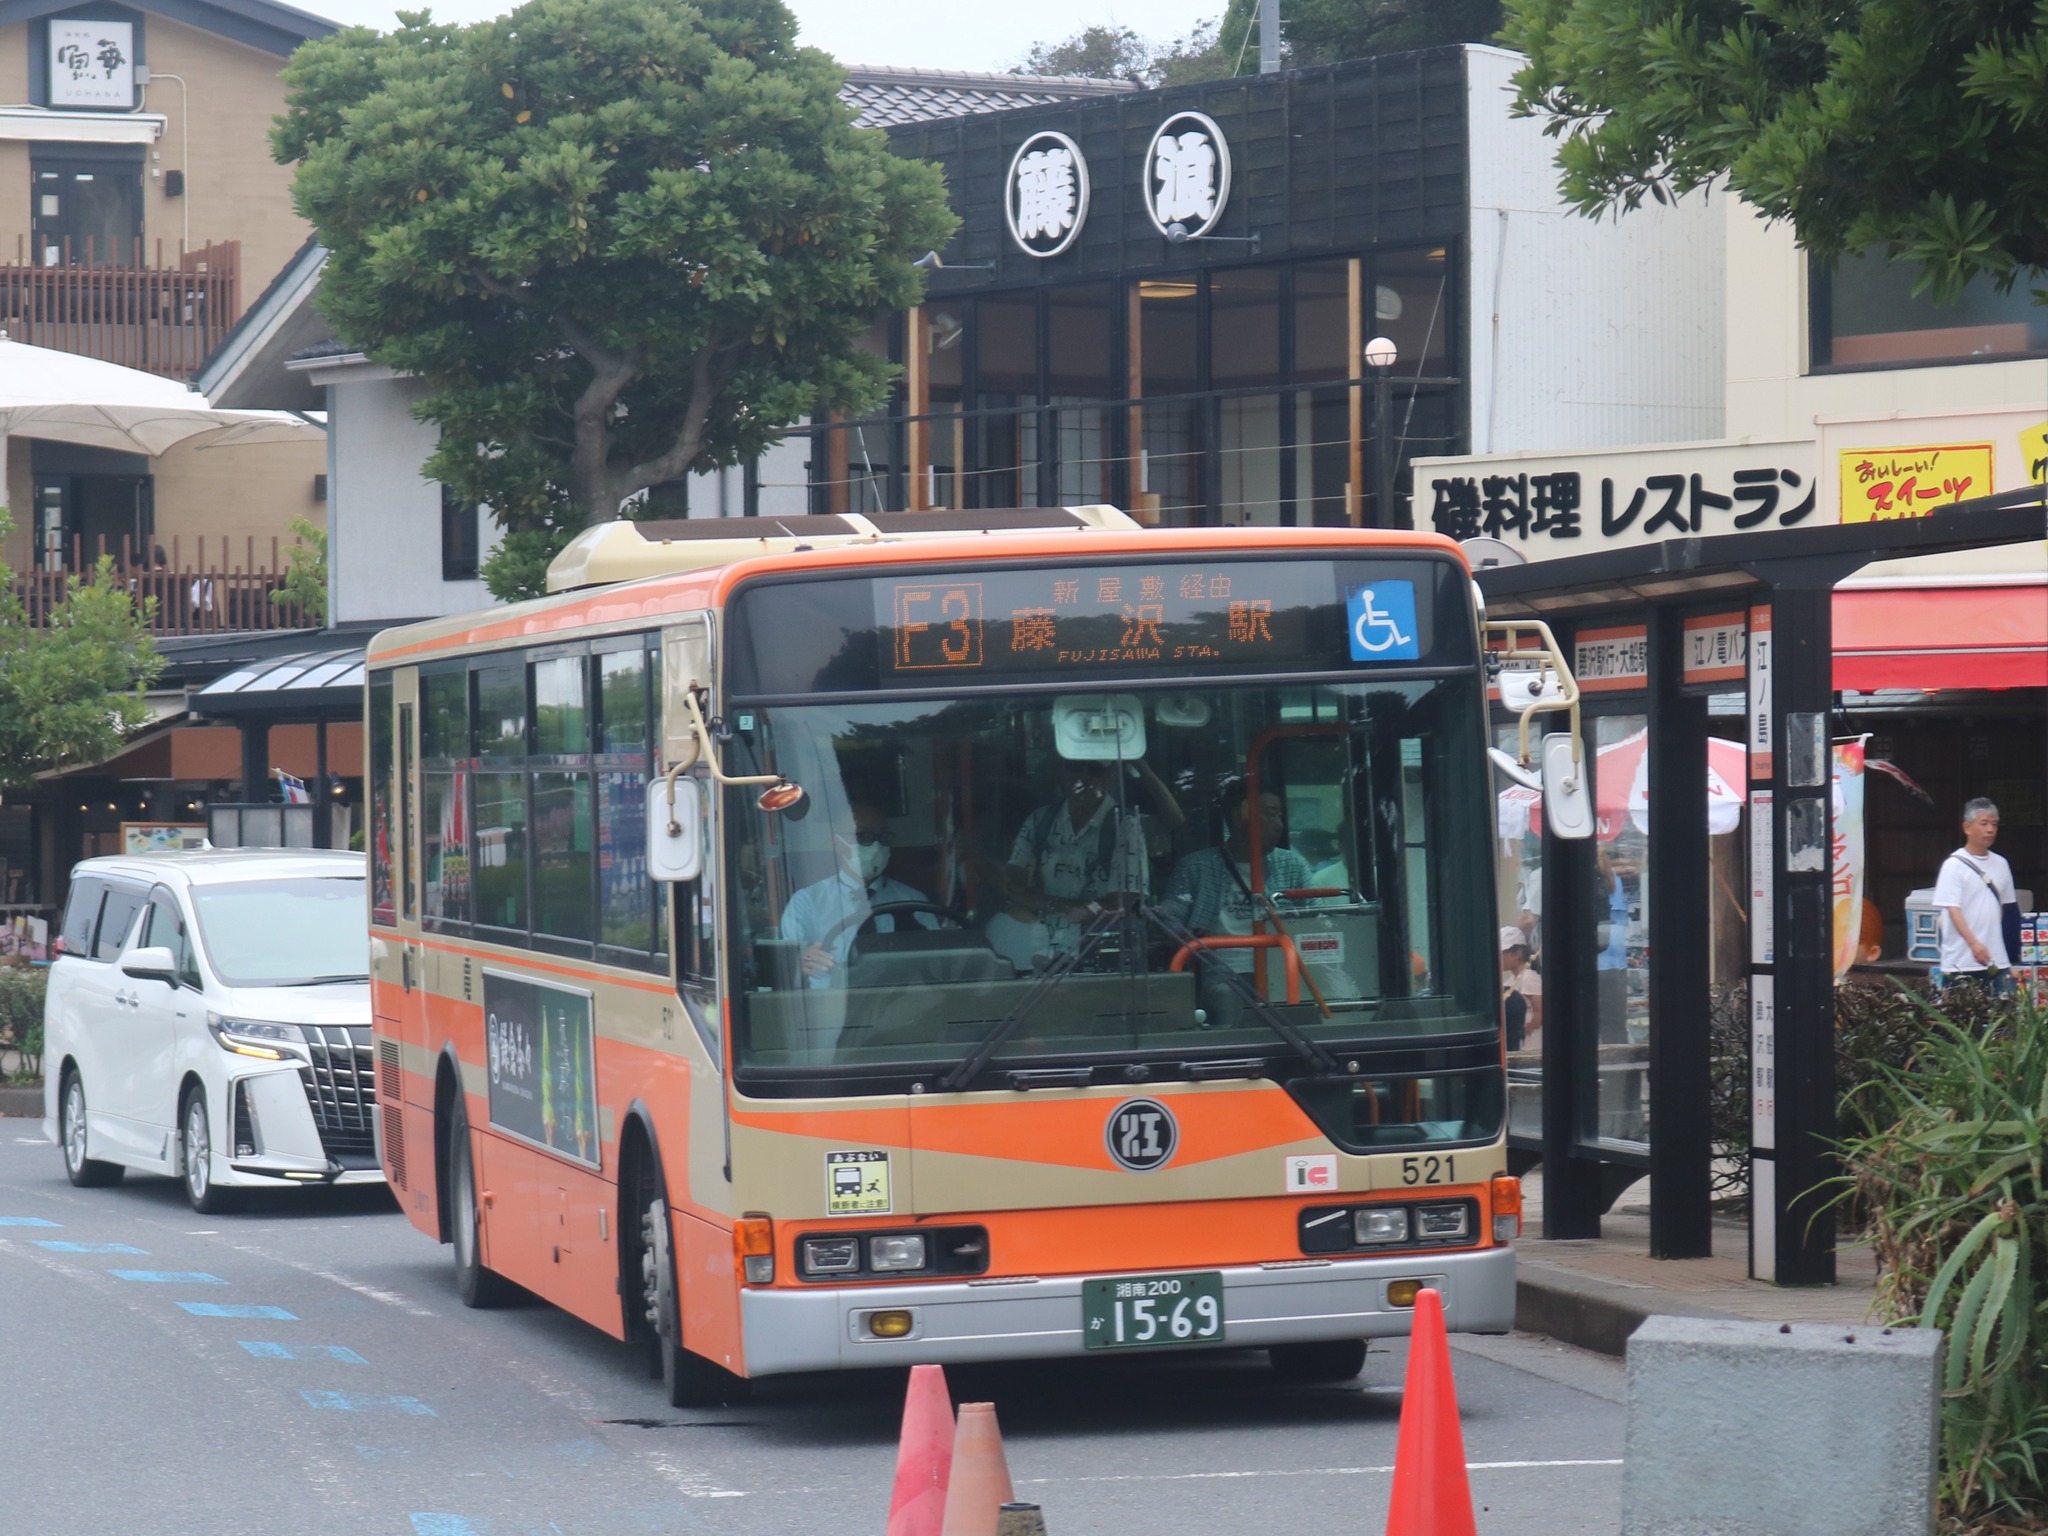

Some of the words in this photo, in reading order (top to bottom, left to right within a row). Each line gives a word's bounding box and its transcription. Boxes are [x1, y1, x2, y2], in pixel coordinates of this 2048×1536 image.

[1431, 471, 1580, 541] 磯料理
[1600, 466, 1817, 538] レストラン
[1053, 572, 1233, 605] 新屋敷経由
[902, 590, 970, 663] F3
[1010, 599, 1274, 652] 藤沢駅
[1056, 647, 1160, 664] FUJISAWA
[1757, 641, 1767, 745] 江ノ島
[1402, 1155, 1454, 1184] 521
[1090, 1317, 1105, 1330] か
[1114, 1294, 1219, 1342] 15-69
